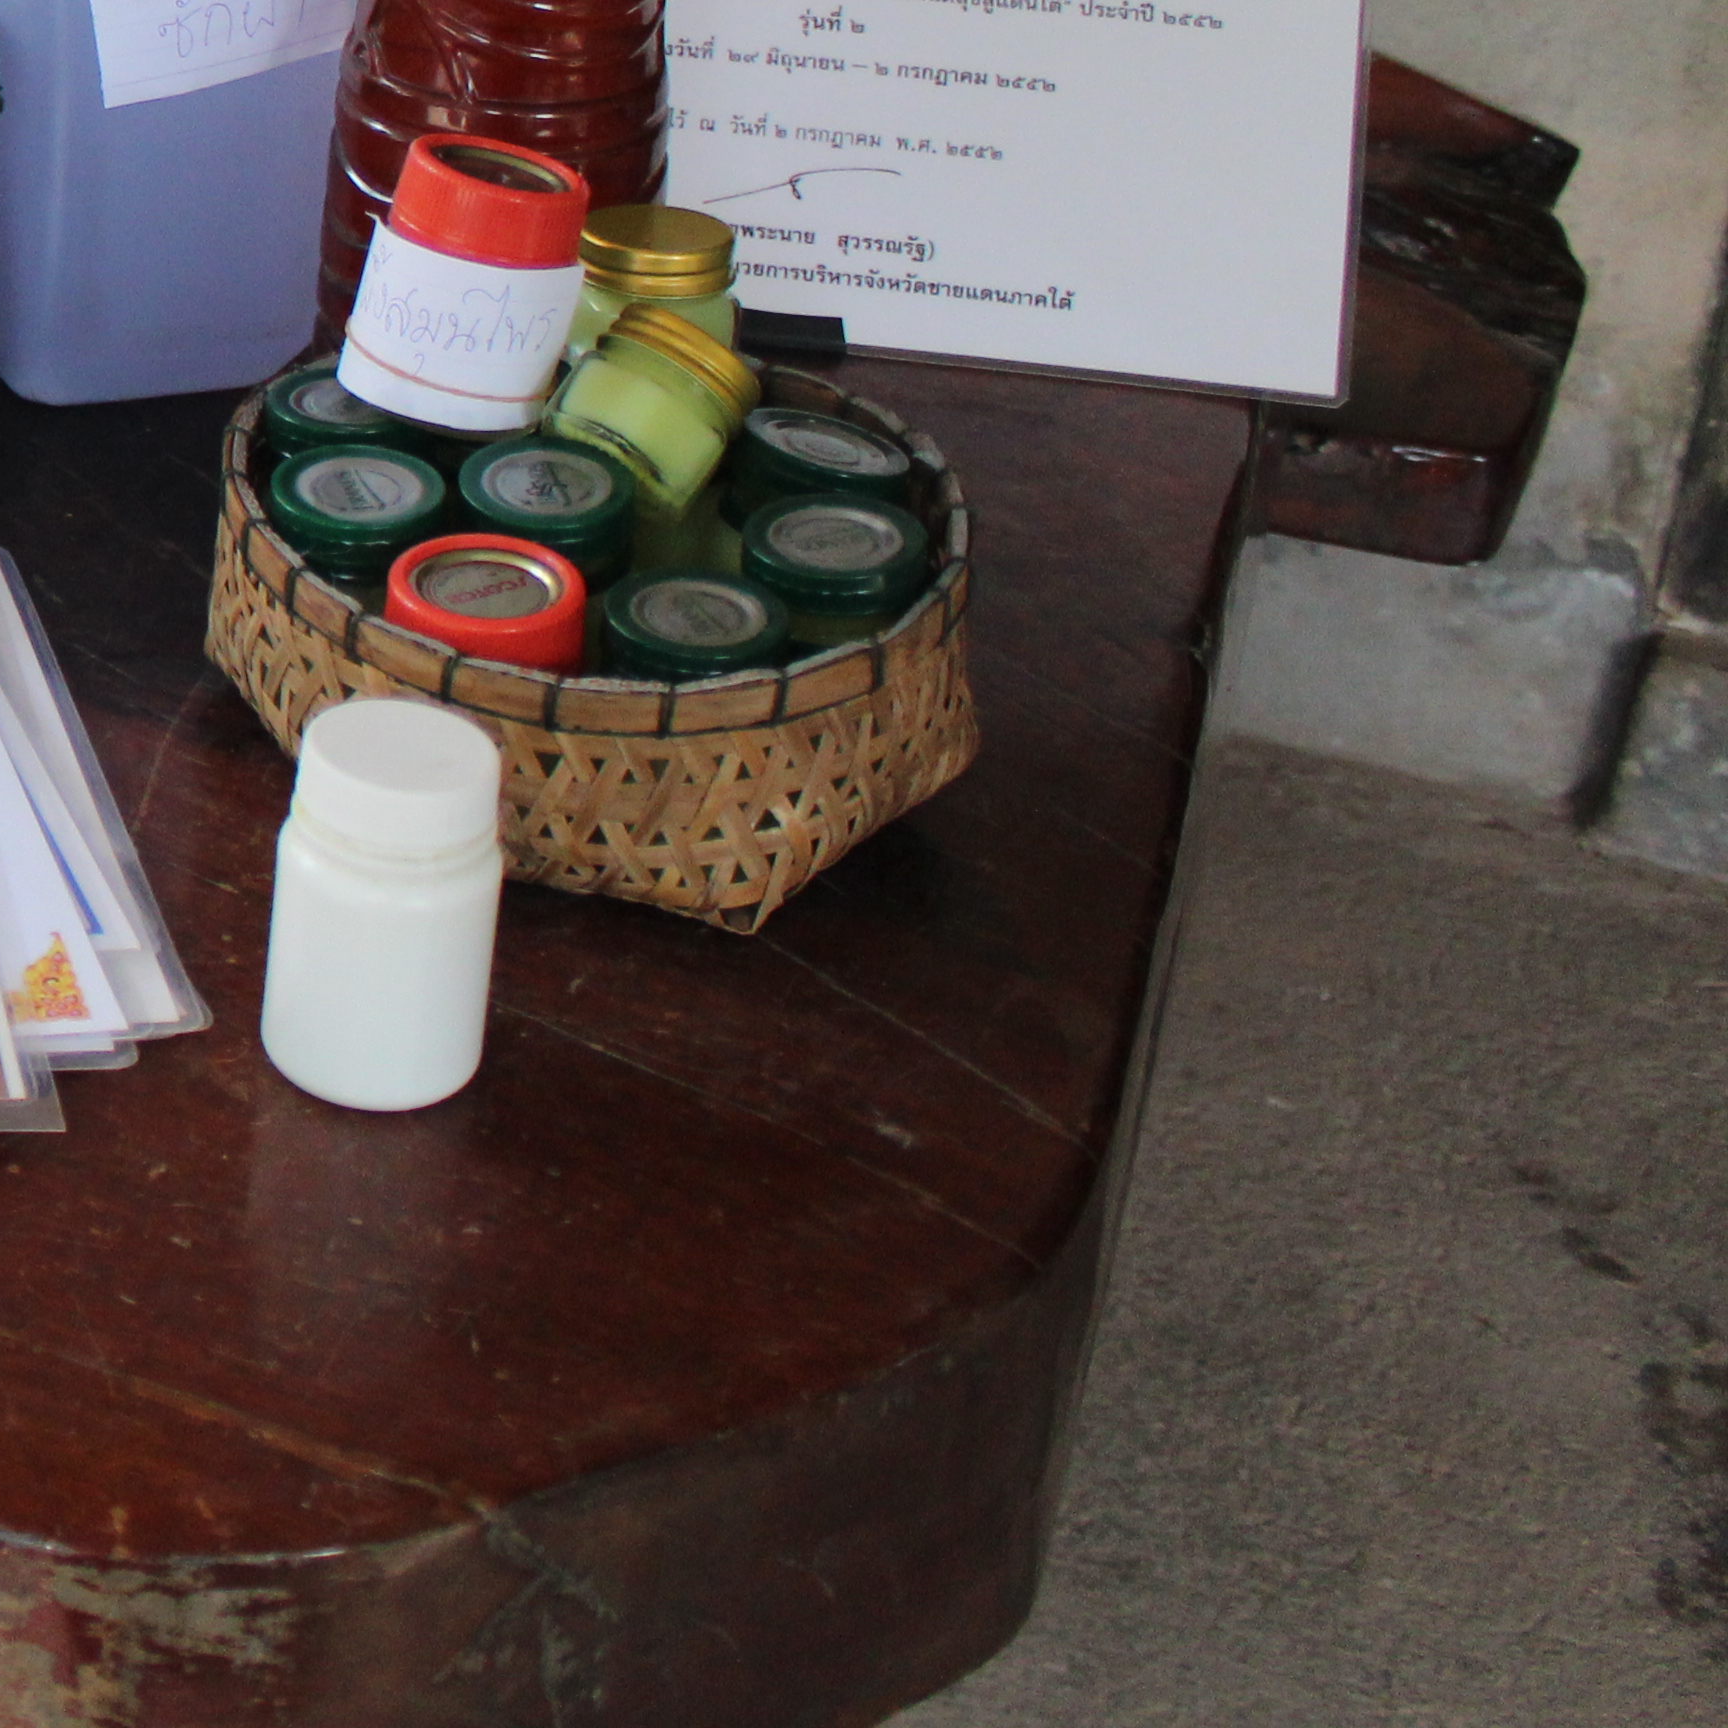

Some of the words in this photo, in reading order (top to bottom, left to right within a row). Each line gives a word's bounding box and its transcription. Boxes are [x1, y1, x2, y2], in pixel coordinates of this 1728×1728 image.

[799, 5, 842, 36] รุ่นที่
[851, 19, 865, 34] ๒
[1080, 0, 1154, 23] ประจำปี
[1162, 10, 1223, 30] ๒๕๕๒
[665, 35, 715, 61] งวันที่
[766, 46, 844, 75] มิถุนายน
[875, 61, 888, 76] ๒
[897, 63, 988, 87] กรกฎาคม
[996, 72, 1056, 93] ๒๕๕๒
[666, 107, 688, 130] ไว้
[700, 118, 715, 132] ณ
[729, 113, 767, 138] วันที่
[774, 125, 788, 140] ๒
[795, 126, 882, 150] กรกฎาคม
[896, 136, 937, 155] พ.ศ.
[946, 141, 1003, 161] ๒๕๕๒
